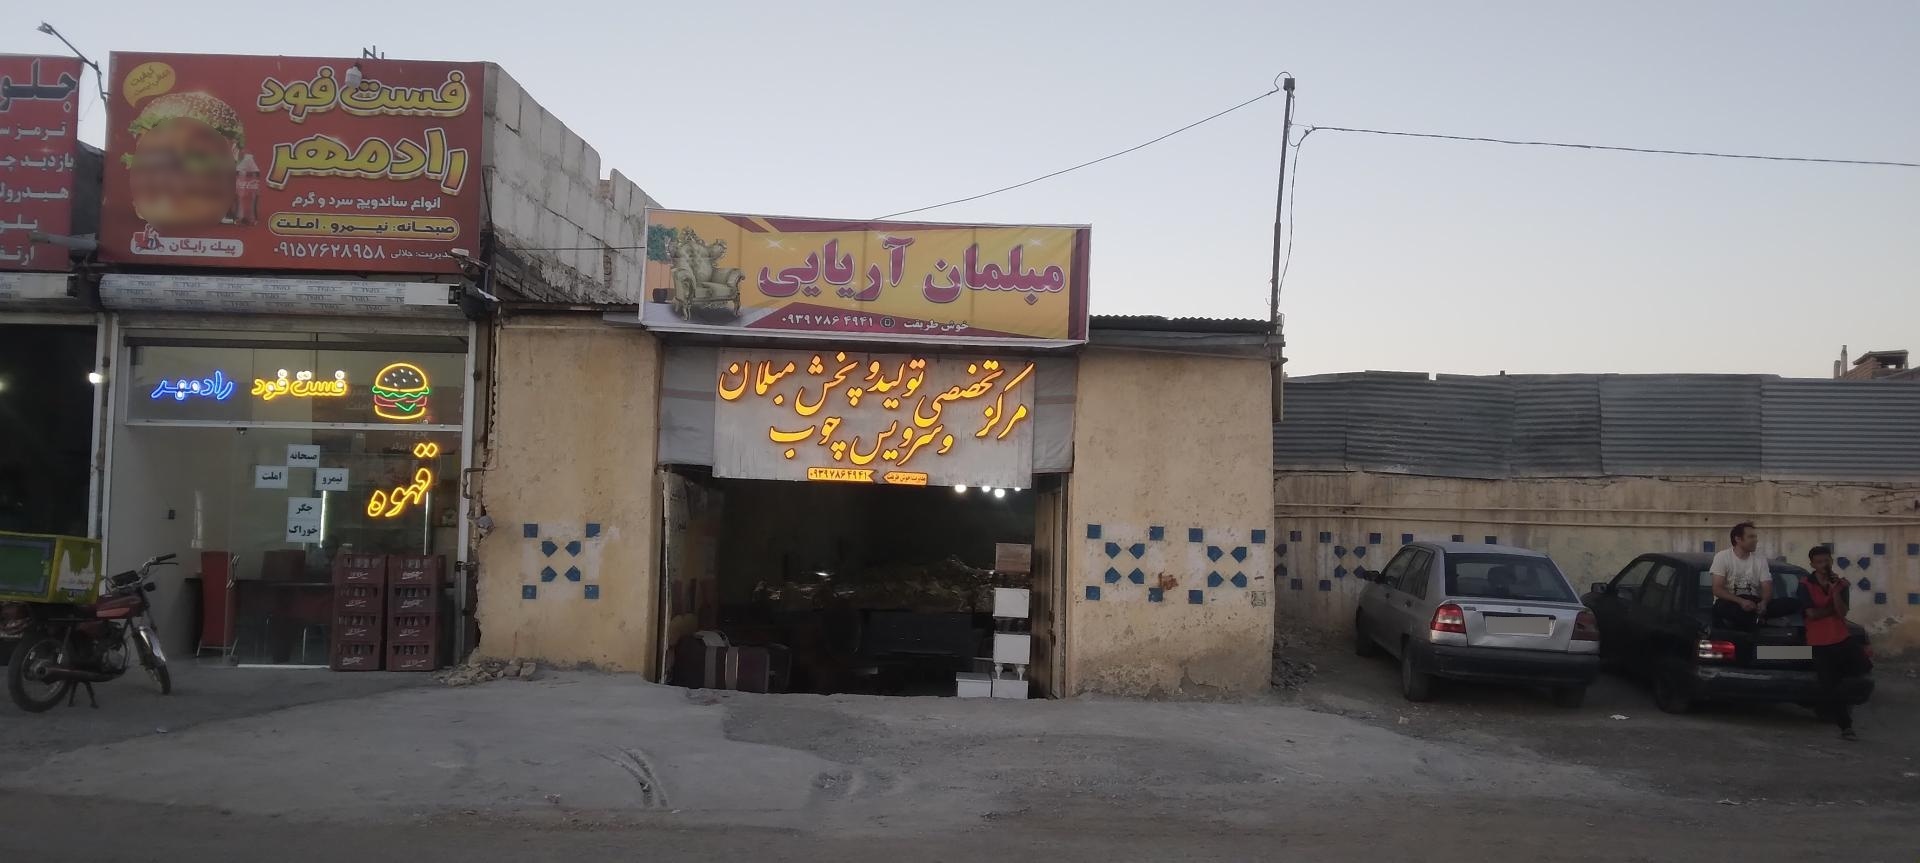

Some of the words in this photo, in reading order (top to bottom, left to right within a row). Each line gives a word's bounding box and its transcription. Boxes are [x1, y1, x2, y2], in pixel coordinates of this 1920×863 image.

[257, 66, 337, 123] فود
[339, 70, 471, 117] فست
[14, 121, 67, 141] ترمز
[20, 152, 75, 173] بازدید
[266, 127, 469, 196] رادمهر
[291, 191, 316, 207] گرم
[317, 197, 326, 208] و
[329, 196, 354, 208] سرد
[356, 195, 408, 210] ساندویچ
[410, 196, 441, 212] انواع
[276, 218, 320, 230] املت
[330, 221, 388, 234] نیمرو
[169, 239, 207, 254] رایگان
[273, 241, 386, 260] ۰۹۱۵۷۶۲۸۹۵۸
[415, 250, 455, 260] دیریت:
[757, 236, 915, 301] آریایی
[921, 243, 1067, 305] مبلمان
[782, 313, 811, 325] ۰۹۳۹
[814, 314, 839, 326] ۷۸۶
[844, 316, 873, 327] ۴۹۴۱
[150, 370, 233, 400] رادمهر
[251, 368, 289, 401] فود
[289, 368, 348, 398] فست
[718, 359, 796, 405] مبلمان
[795, 351, 863, 416] پخش
[866, 358, 926, 410] تولید
[913, 359, 1005, 428] تخصصی
[976, 362, 1035, 440] مرکز
[768, 415, 847, 460] چوب
[849, 420, 944, 466] سرویس
[261, 471, 282, 481] املت
[321, 473, 343, 485] نیمرو
[367, 442, 438, 518] قهوه
[295, 504, 313, 514] جگر
[288, 524, 318, 537] خوراک
